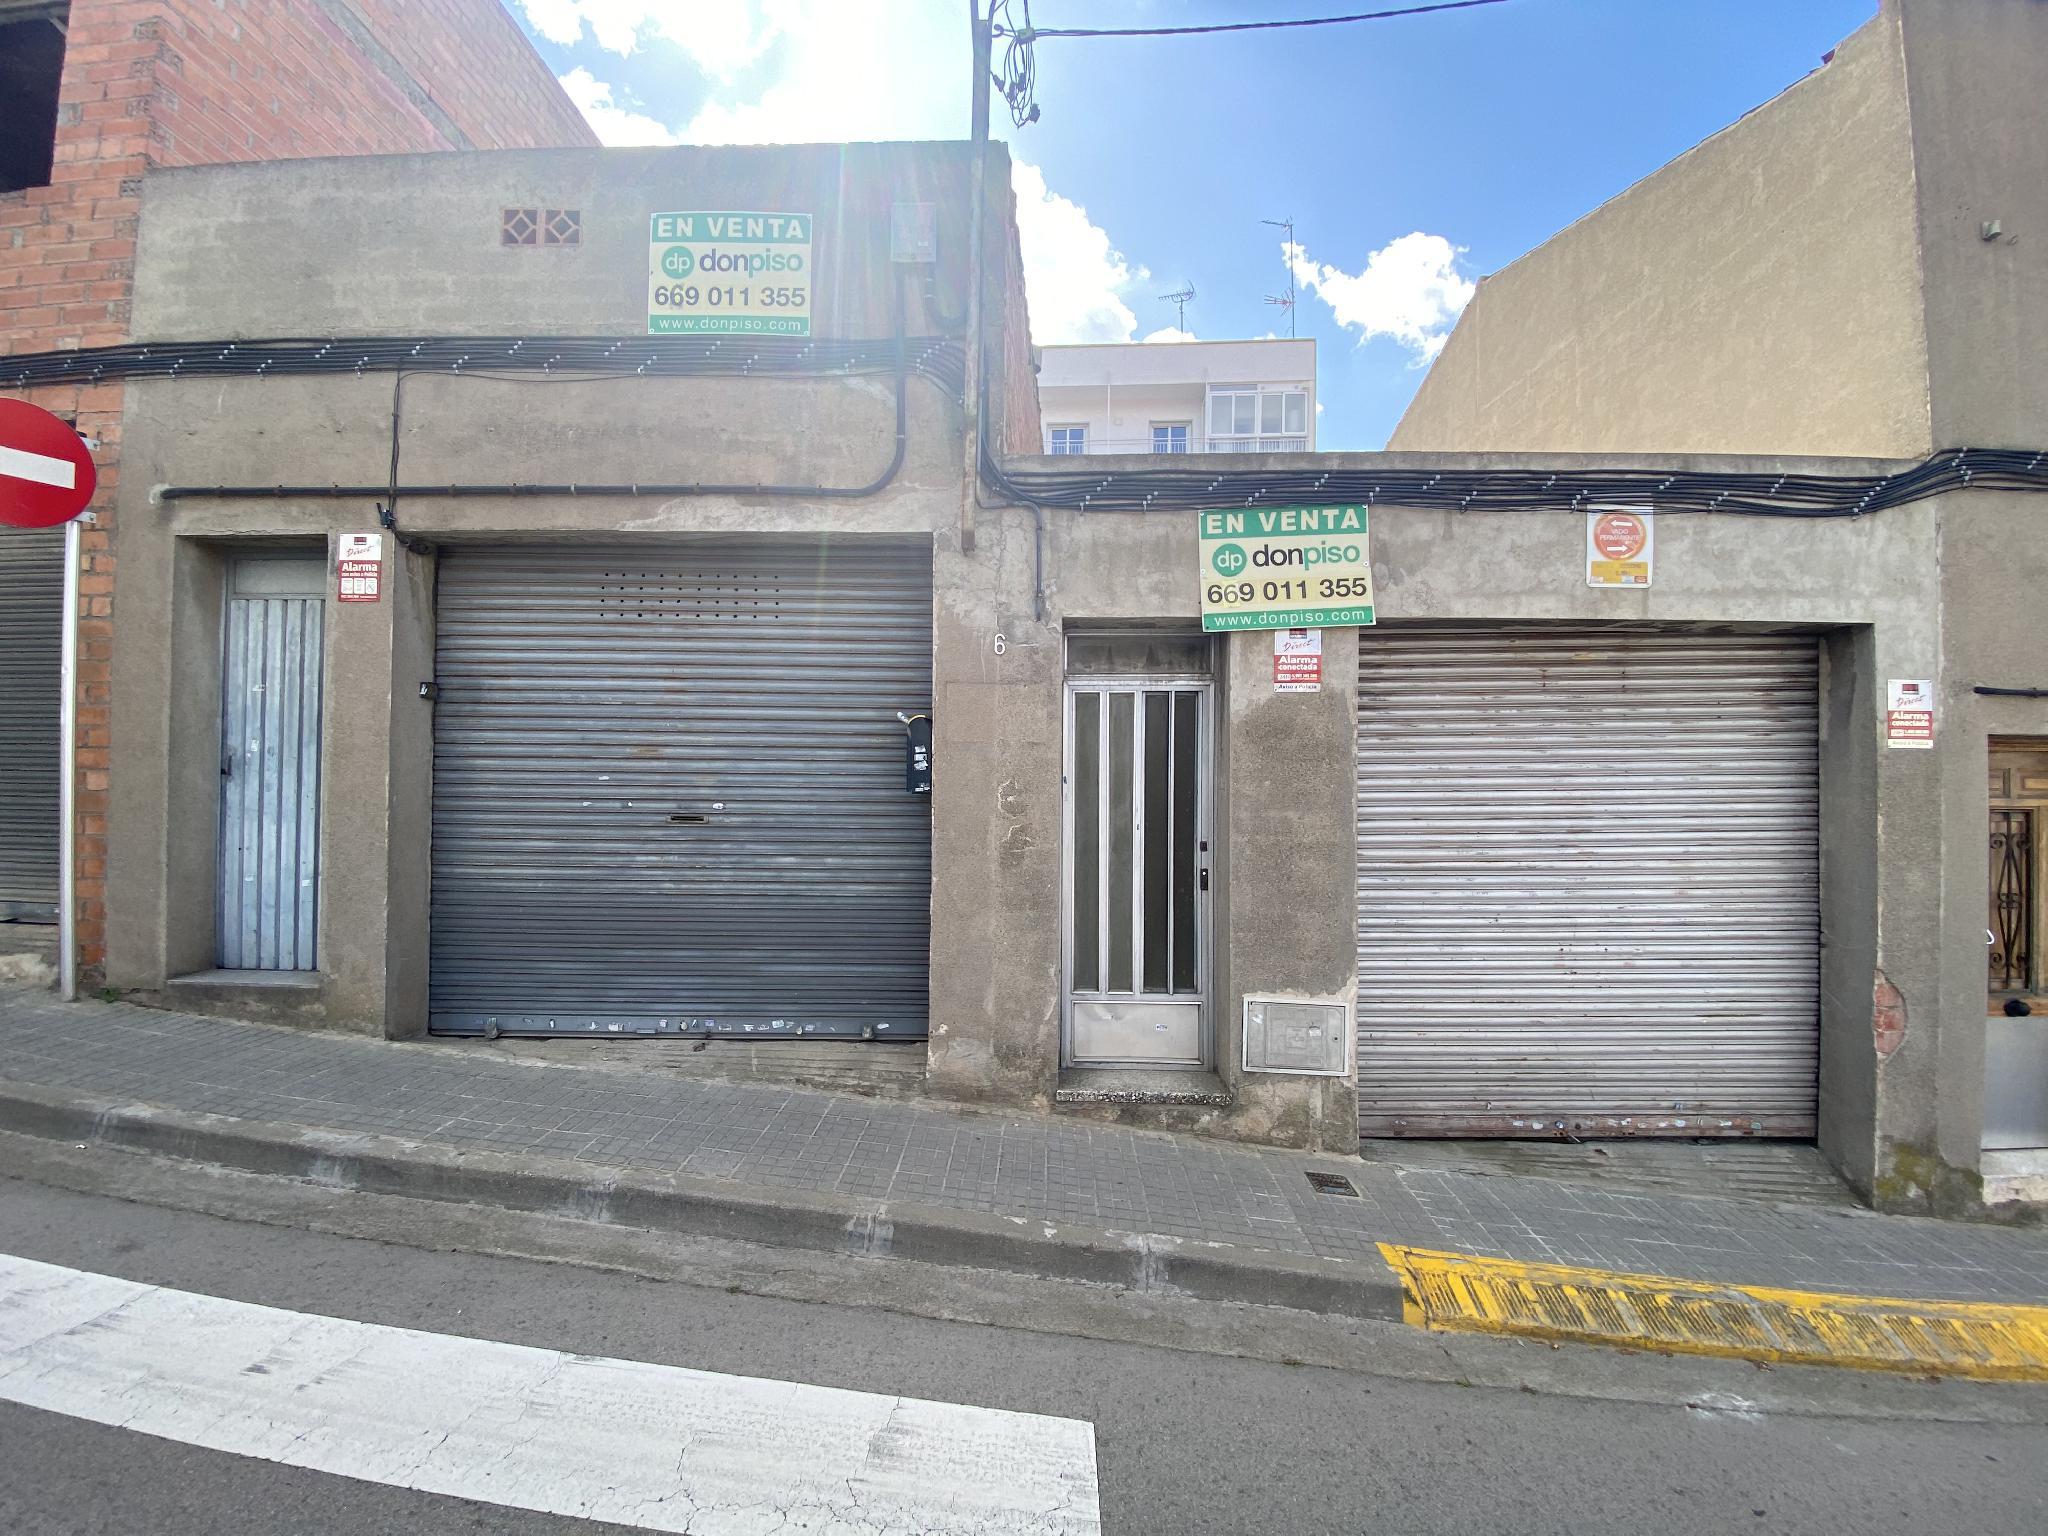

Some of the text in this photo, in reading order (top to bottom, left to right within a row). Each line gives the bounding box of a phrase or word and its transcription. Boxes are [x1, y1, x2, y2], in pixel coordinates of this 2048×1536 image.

[657, 217, 804, 239] EN VENTA
[665, 248, 804, 278] dp donpiso
[654, 285, 806, 307] 669 011 355
[659, 317, 801, 331] www.donpiso.com
[1206, 508, 1361, 535] EN VENTA
[341, 561, 378, 572] Alarma
[1217, 540, 1361, 571] dp donpiso
[1207, 577, 1367, 604] 669 011 355
[1214, 610, 1365, 627] www.donpiso.com
[994, 633, 1006, 655] 6
[1278, 655, 1318, 664] Alarma
[1278, 663, 1318, 671] conectada
[1891, 711, 1930, 720] Alarma
